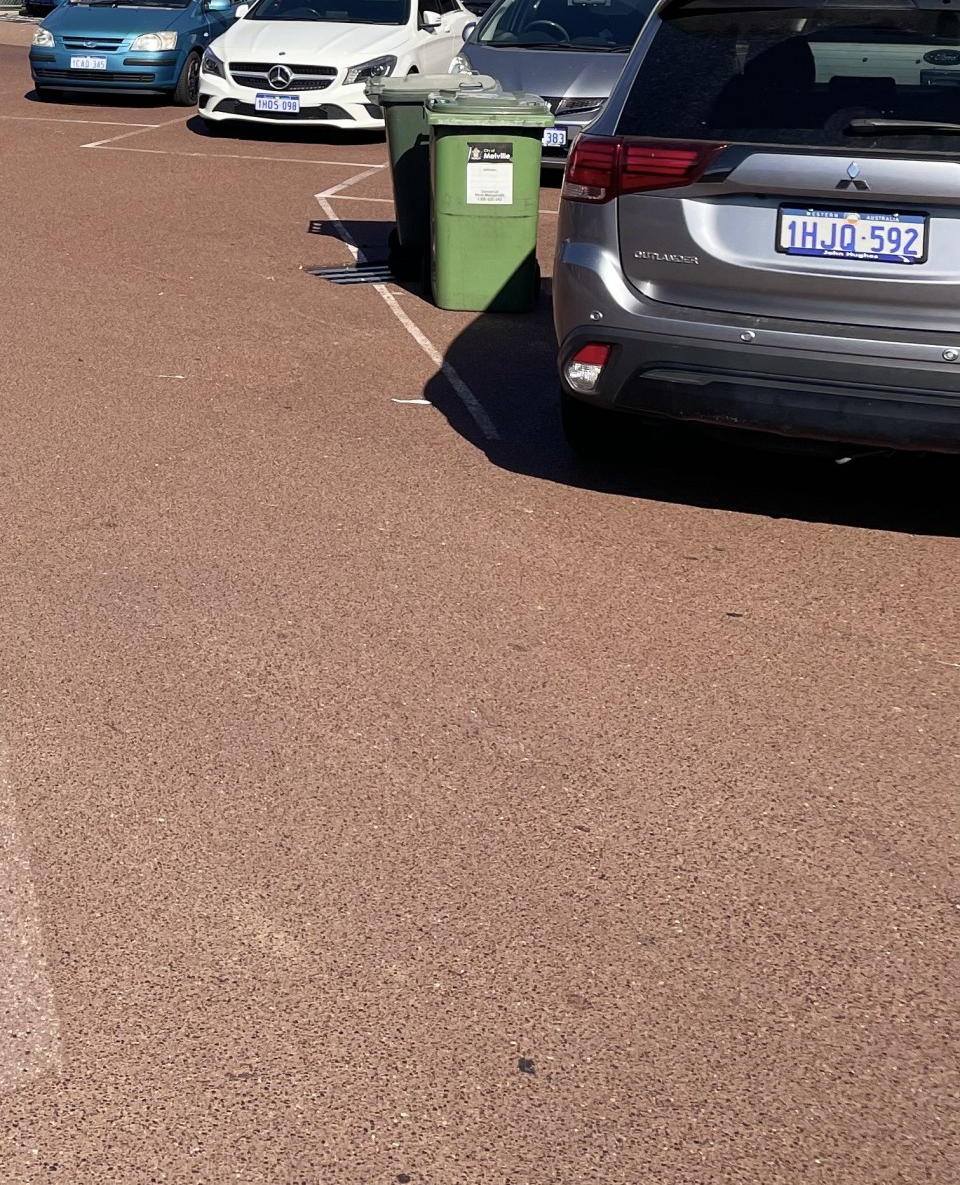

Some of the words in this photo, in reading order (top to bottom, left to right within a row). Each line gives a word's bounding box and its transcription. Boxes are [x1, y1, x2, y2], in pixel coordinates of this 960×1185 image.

[546, 132, 565, 144] 383
[483, 152, 511, 160] Melville
[806, 211, 839, 219] WESTERN
[866, 215, 900, 223] AUSTRALIA
[634, 250, 699, 265] OUTLANDER
[846, 250, 879, 259] Hughes
